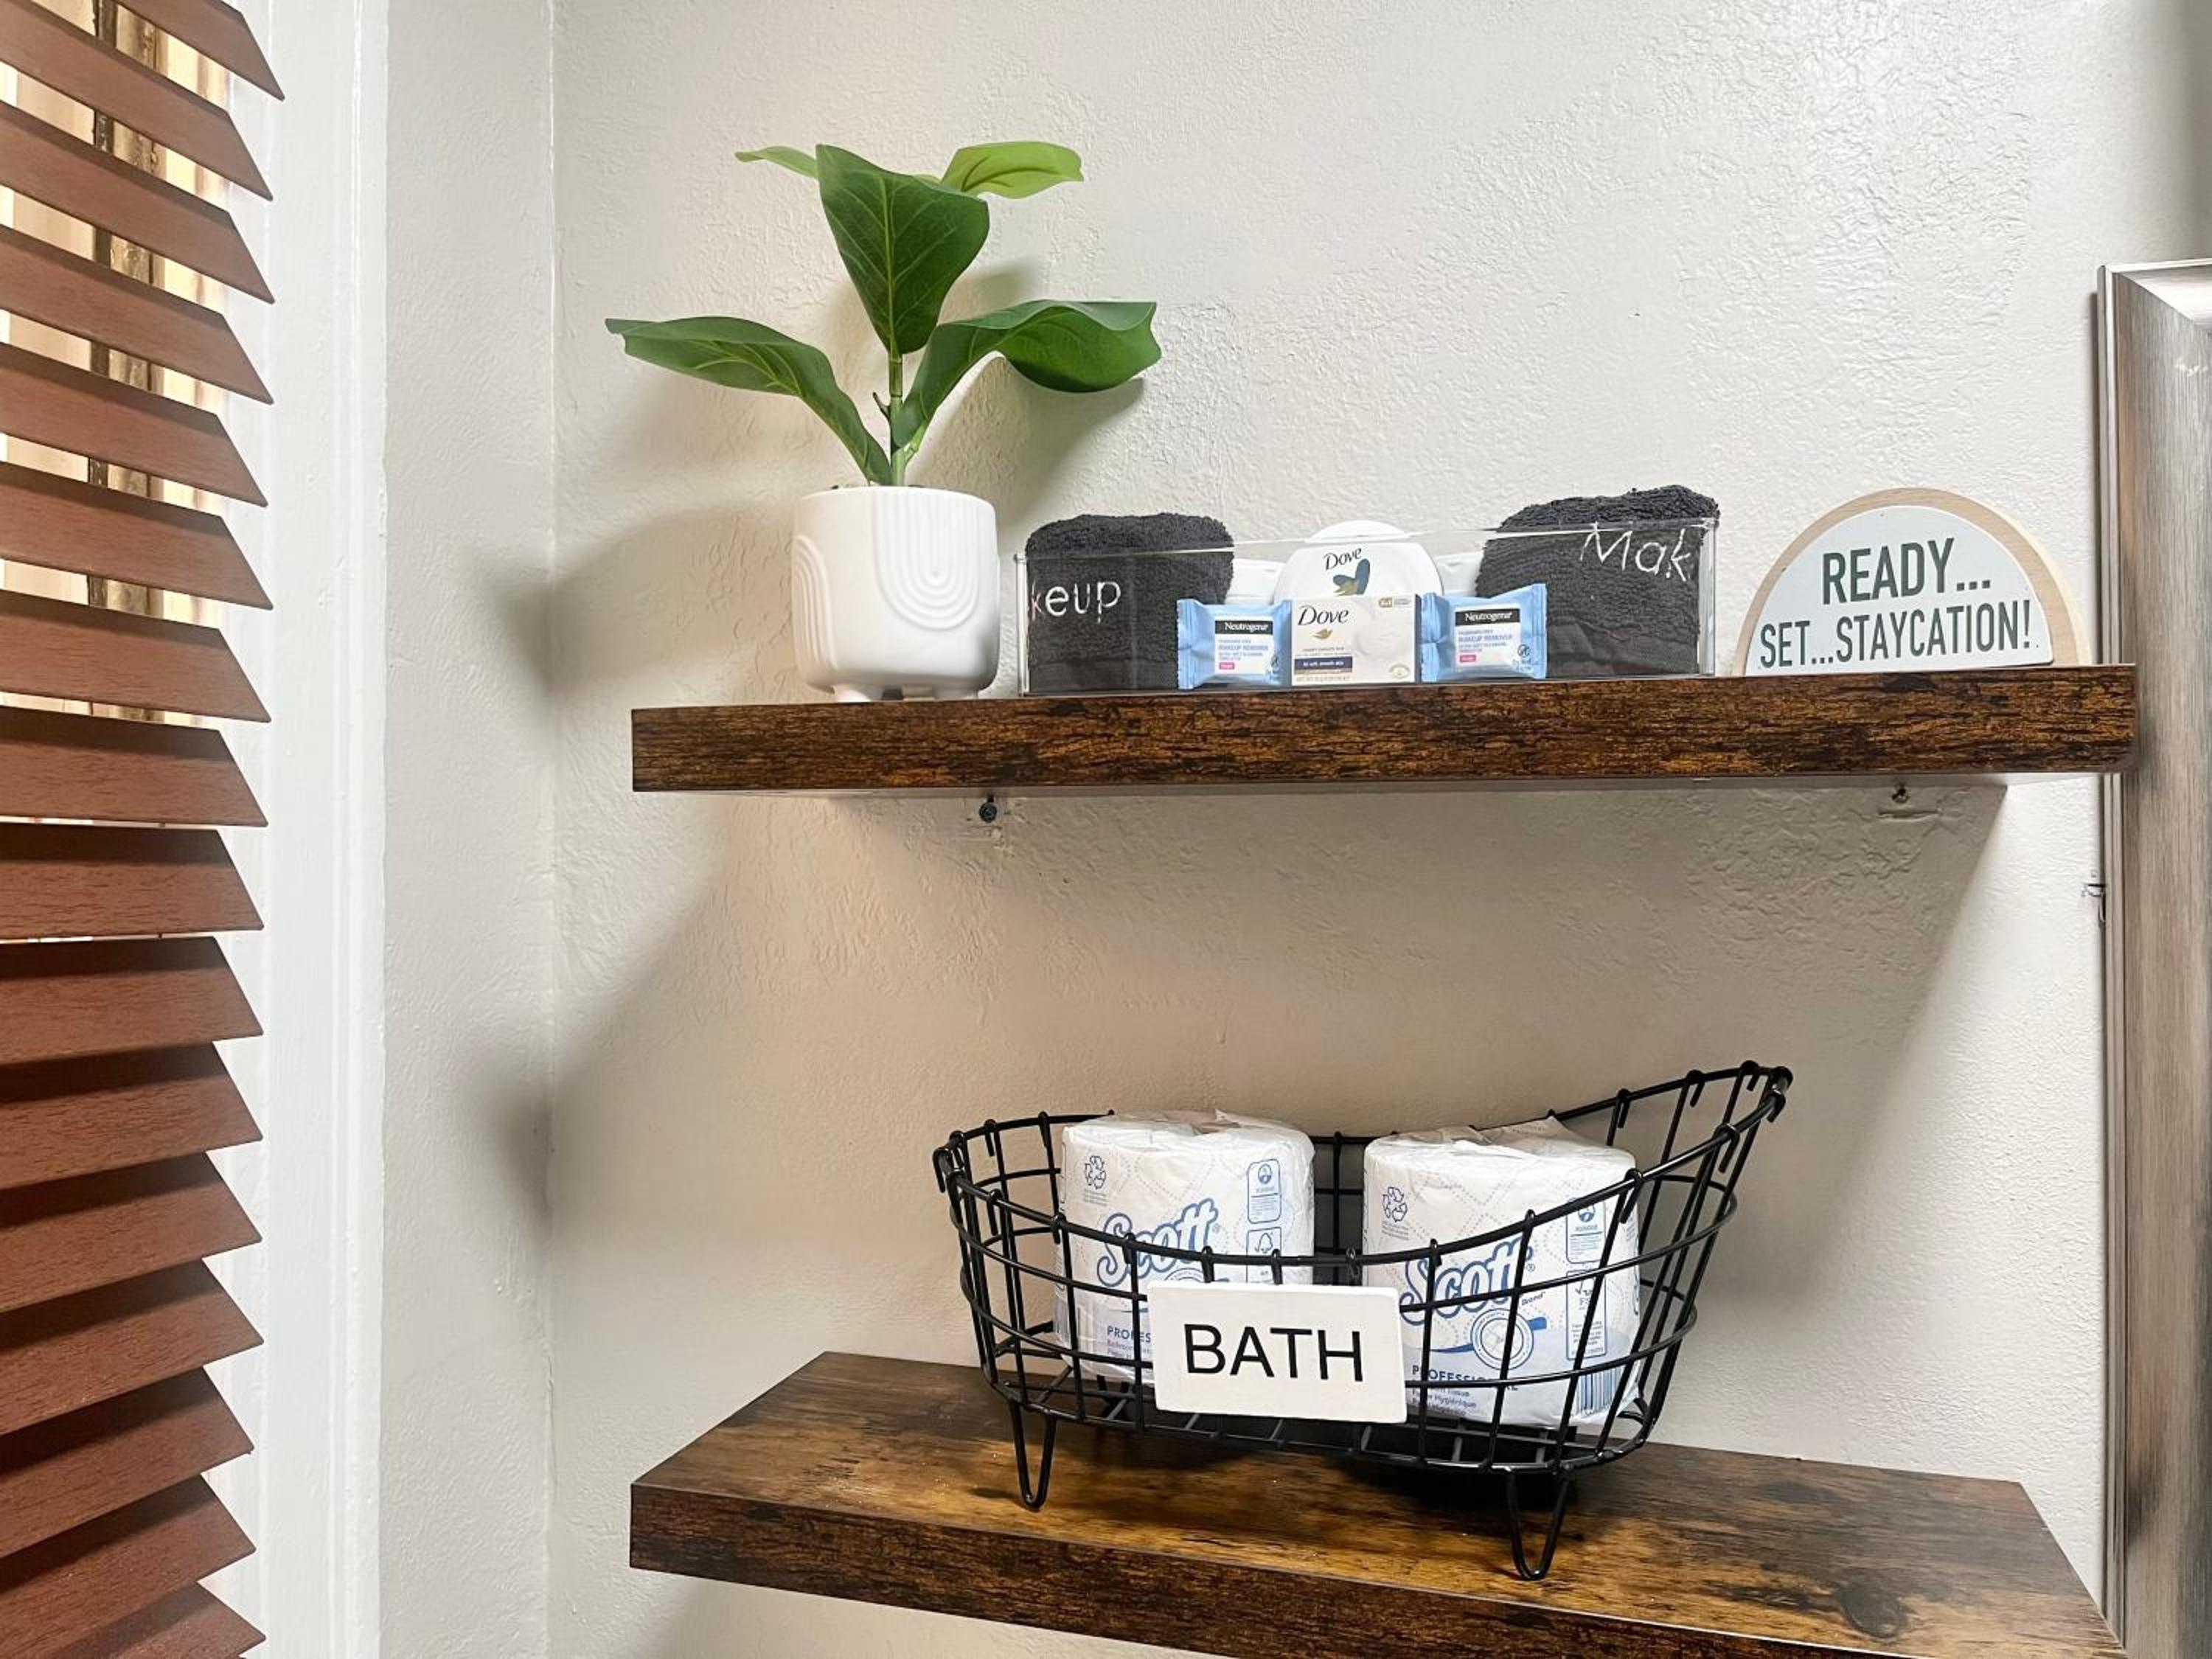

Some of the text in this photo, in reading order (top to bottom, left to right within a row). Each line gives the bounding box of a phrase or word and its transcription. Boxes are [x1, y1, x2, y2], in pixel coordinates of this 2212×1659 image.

[1324, 548, 1362, 570] Dove
[1822, 538, 1991, 605] READY...
[1298, 605, 1349, 626] Dove
[1465, 611, 1512, 622] Neutrogena
[1225, 622, 1268, 633] Neutrogena
[1096, 1197, 1219, 1287] Scott
[1183, 1324, 1364, 1382] BATH
